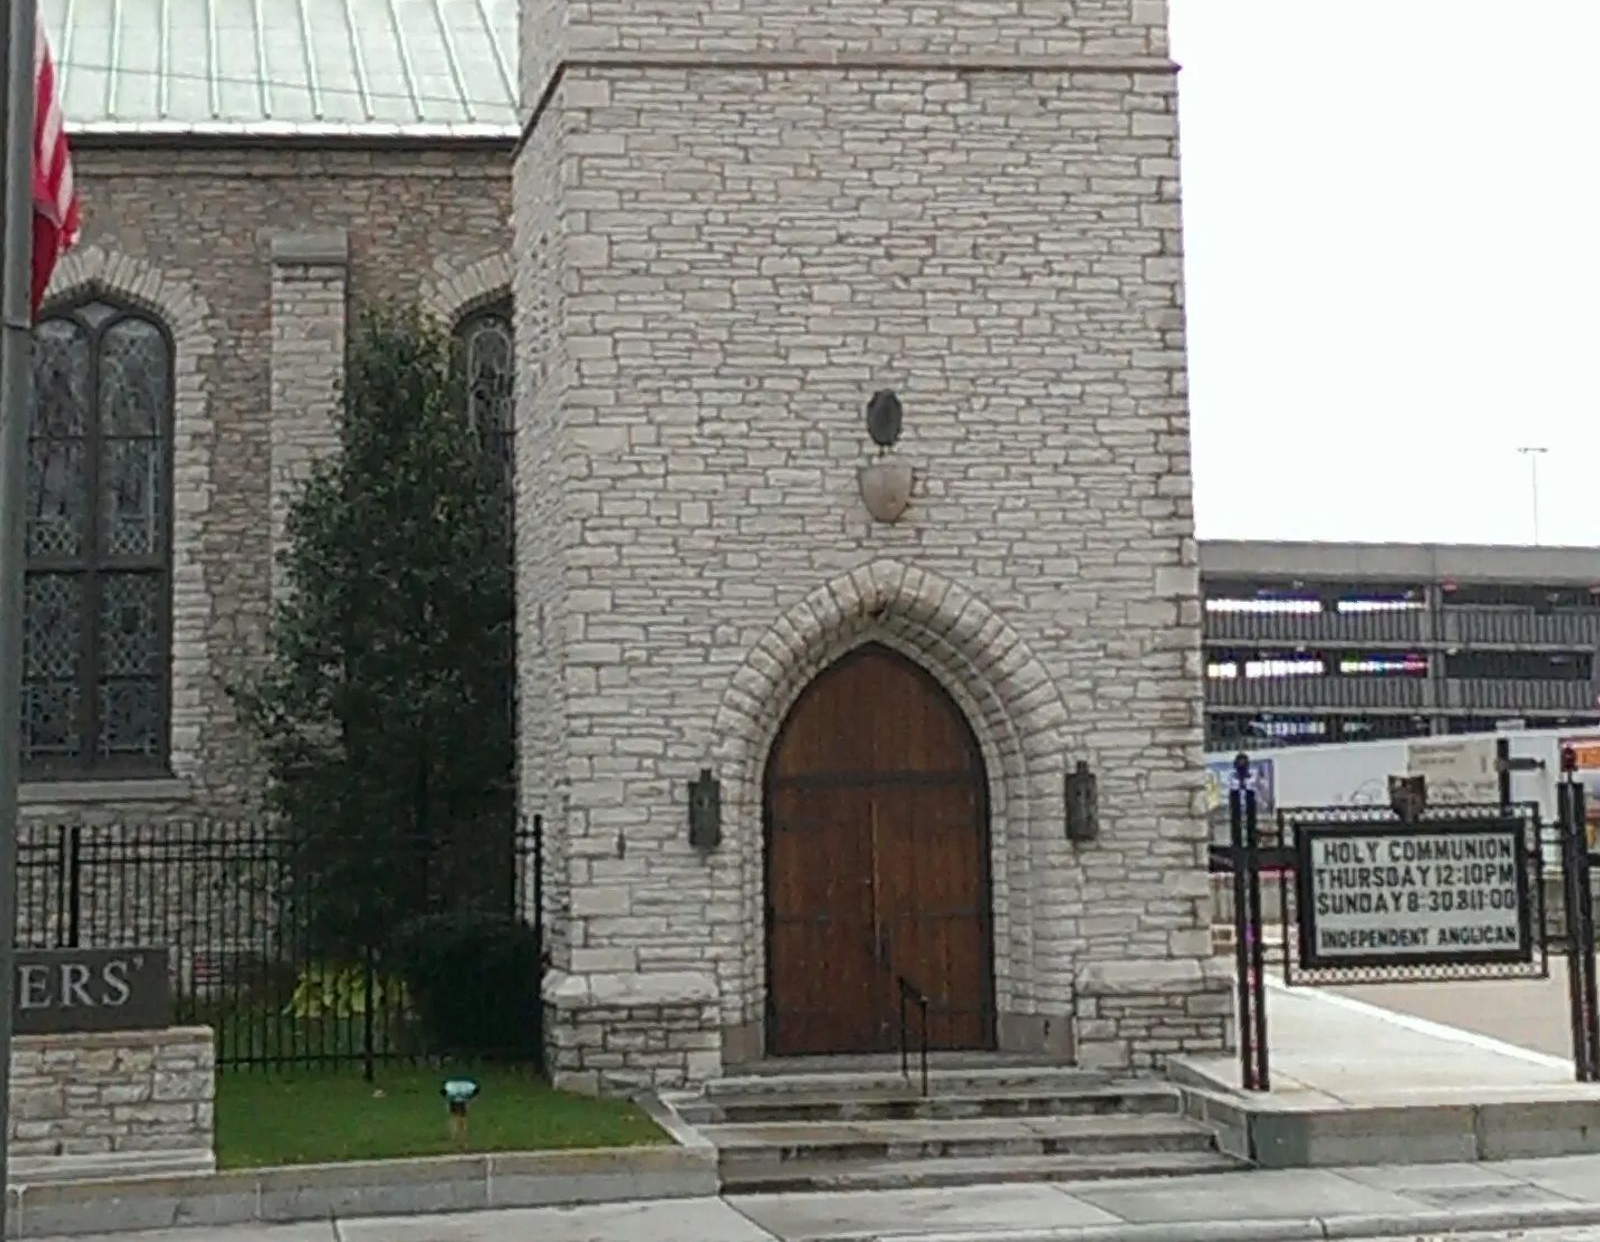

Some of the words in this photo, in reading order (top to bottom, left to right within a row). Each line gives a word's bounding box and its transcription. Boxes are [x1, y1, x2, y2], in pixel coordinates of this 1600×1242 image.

[1323, 841, 1379, 864] HOLY
[1388, 838, 1511, 861] COMMUNION
[1315, 866, 1430, 890] THURSDAY
[1317, 892, 1403, 916] SUNDAY
[1321, 927, 1429, 948] INDEPENDENT
[1438, 925, 1516, 945] ANGLICAN
